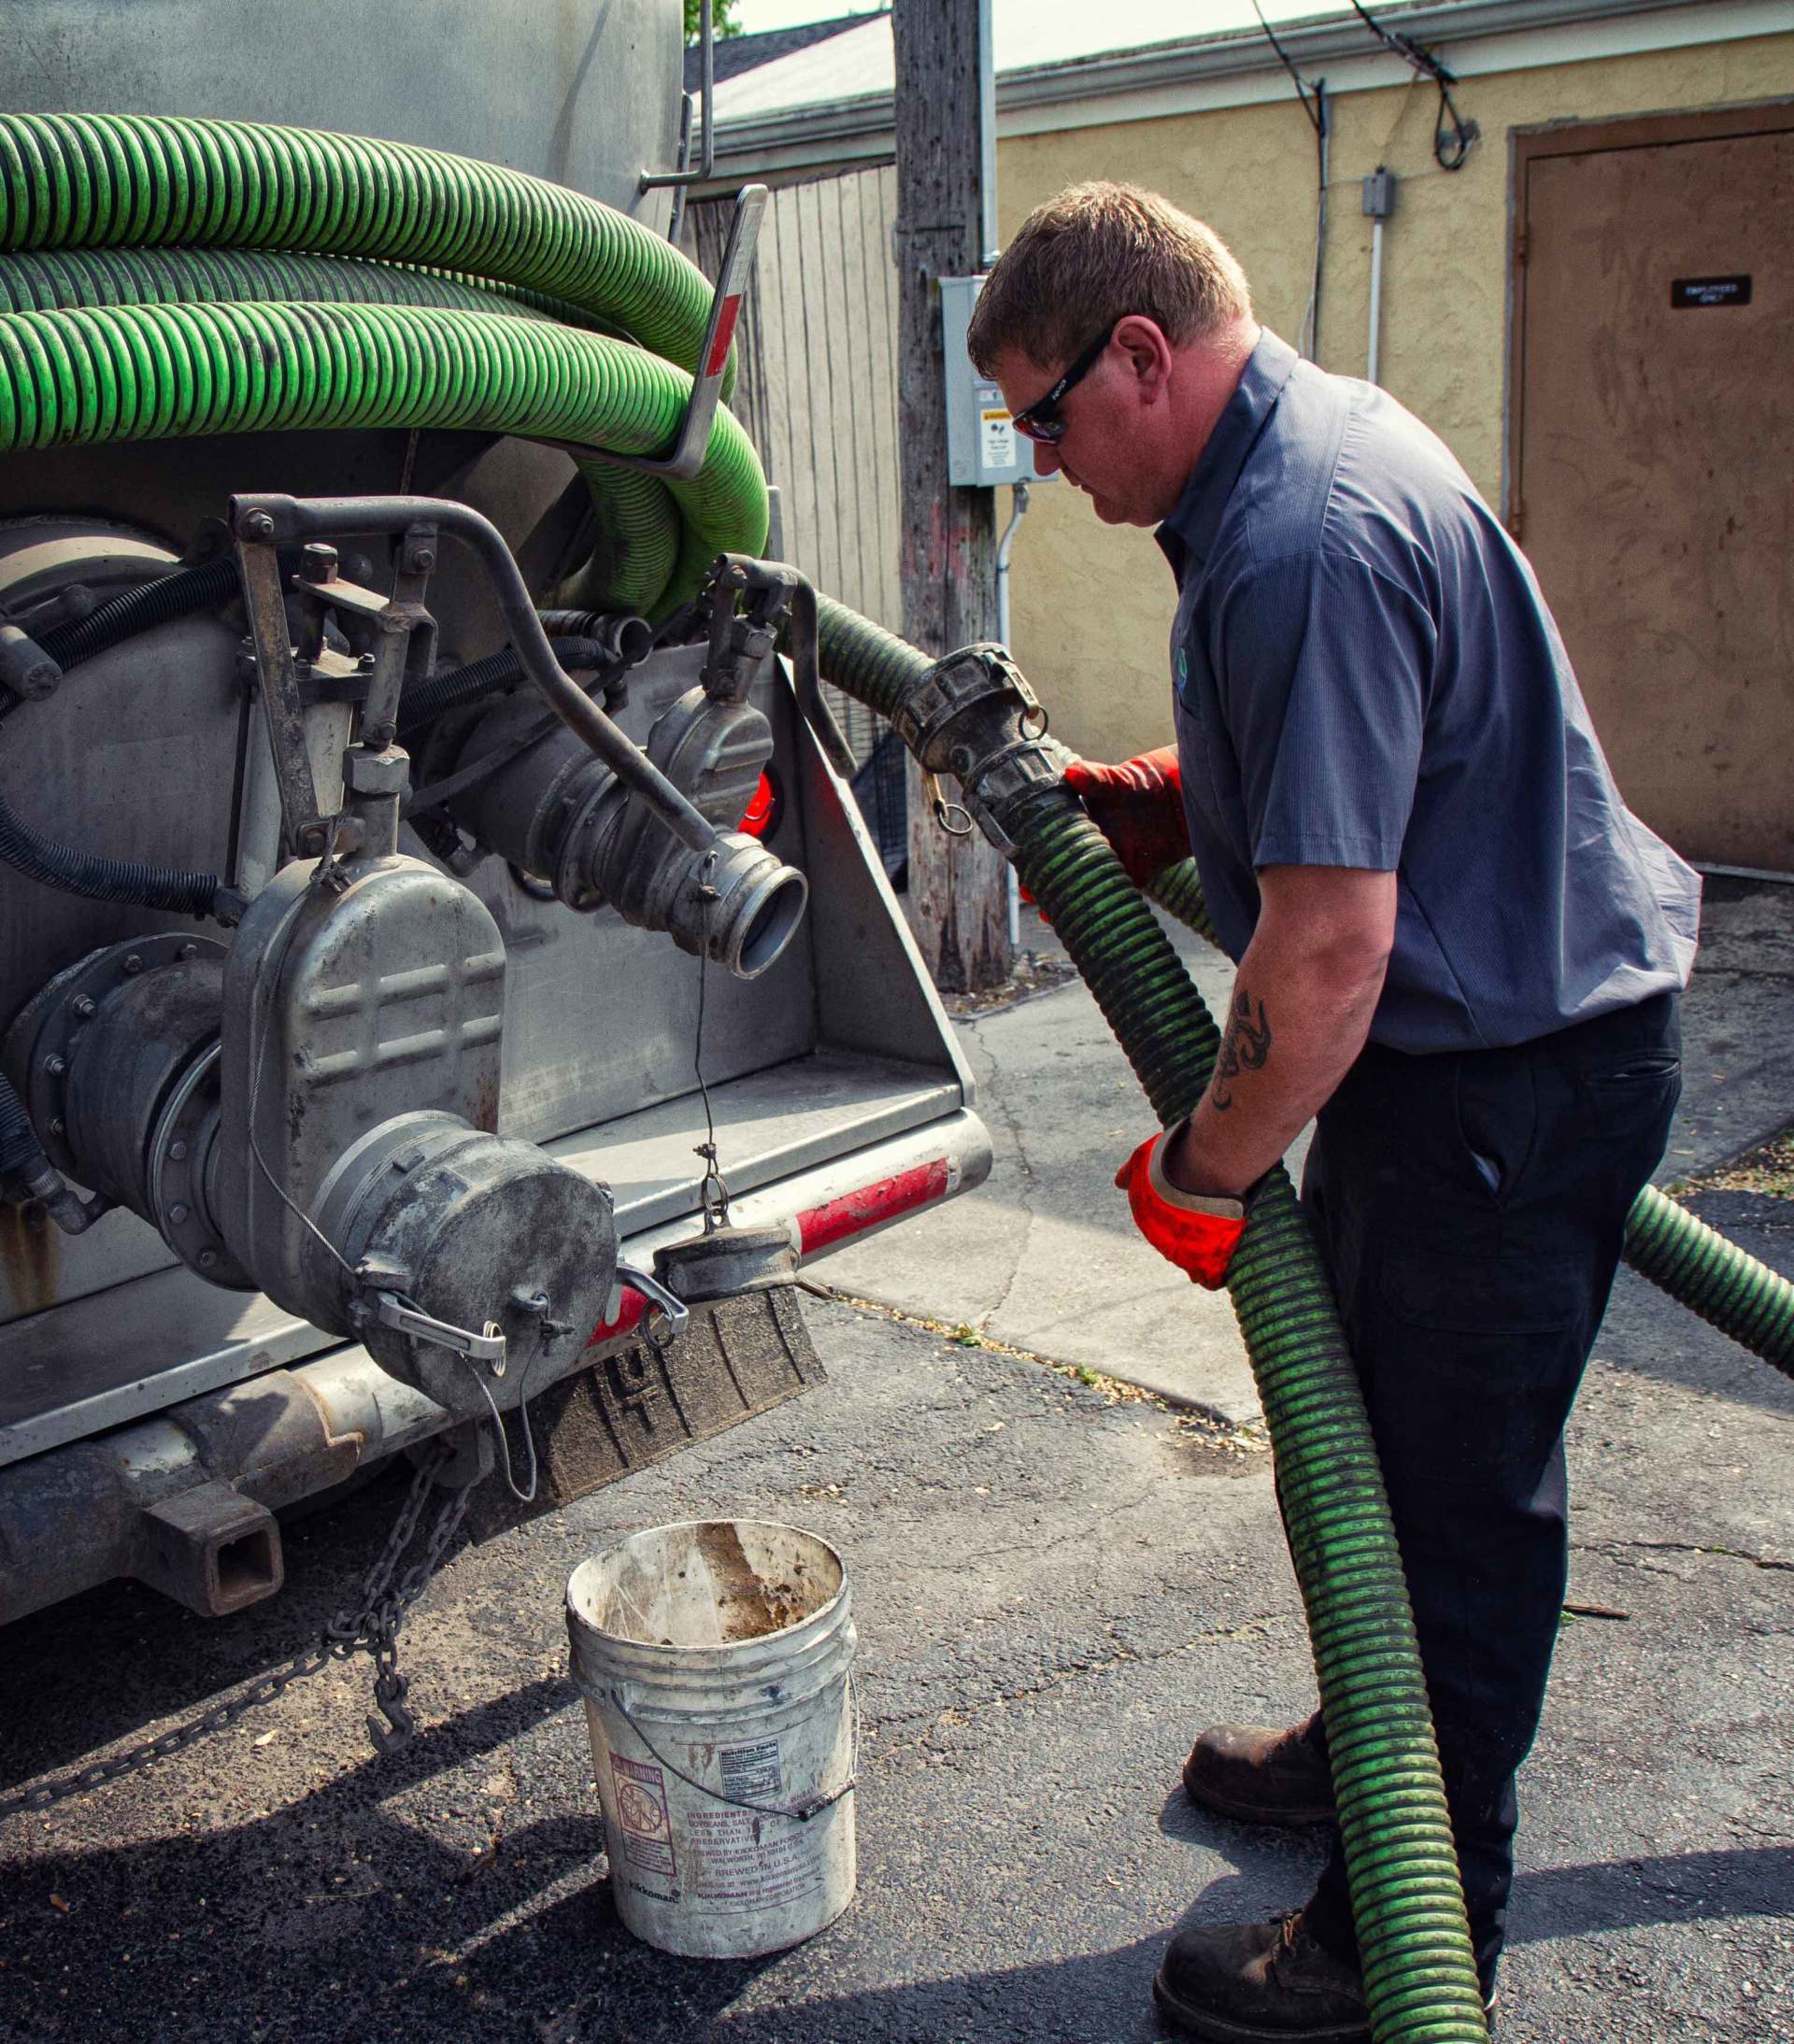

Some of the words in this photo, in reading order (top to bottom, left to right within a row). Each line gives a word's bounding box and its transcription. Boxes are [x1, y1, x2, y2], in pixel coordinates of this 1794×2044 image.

[720, 1747, 755, 1757] Nutrition
[756, 1742, 777, 1752] Facts
[620, 1760, 662, 1783] WARNING
[717, 1827, 741, 1837] THAN
[715, 1865, 758, 1878] BREWED
[761, 1862, 772, 1871] IN
[629, 1879, 676, 1903] kikkoman
